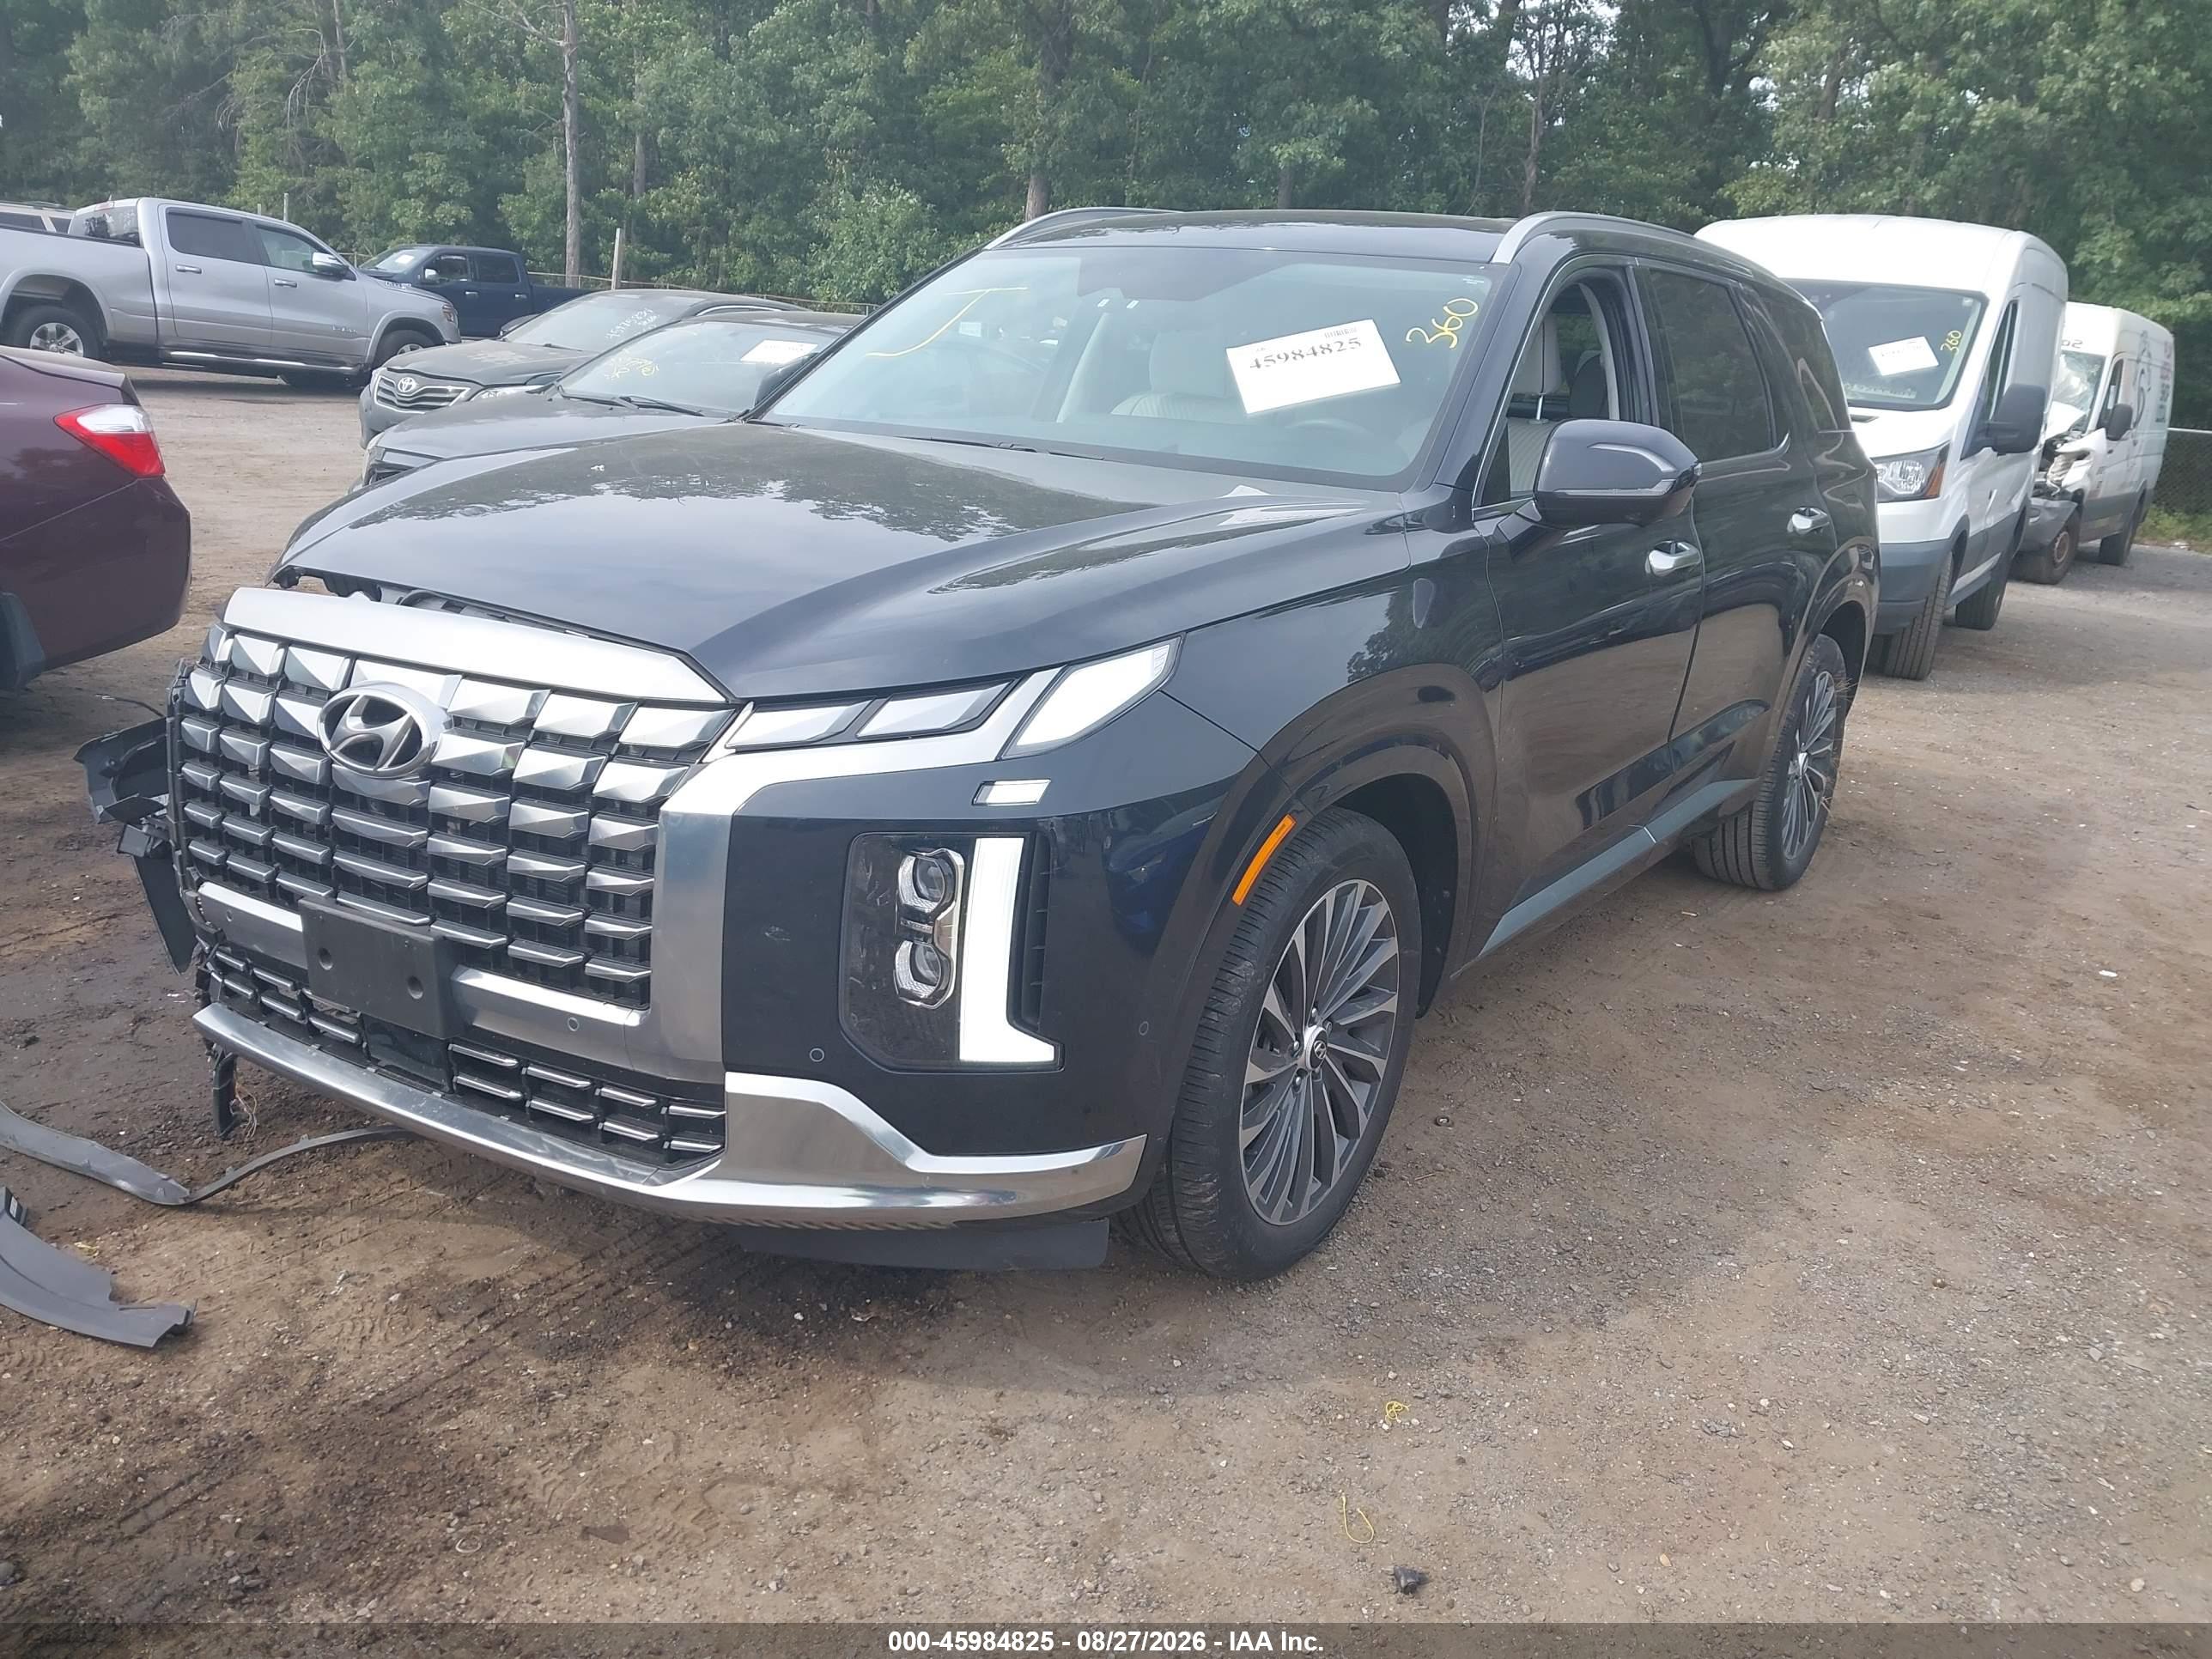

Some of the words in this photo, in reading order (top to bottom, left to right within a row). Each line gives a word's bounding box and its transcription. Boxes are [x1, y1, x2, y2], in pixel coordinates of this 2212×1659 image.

[1402, 297, 1479, 349] 360
[1249, 337, 1362, 369] 45984825
[1939, 330, 1962, 356] 360
